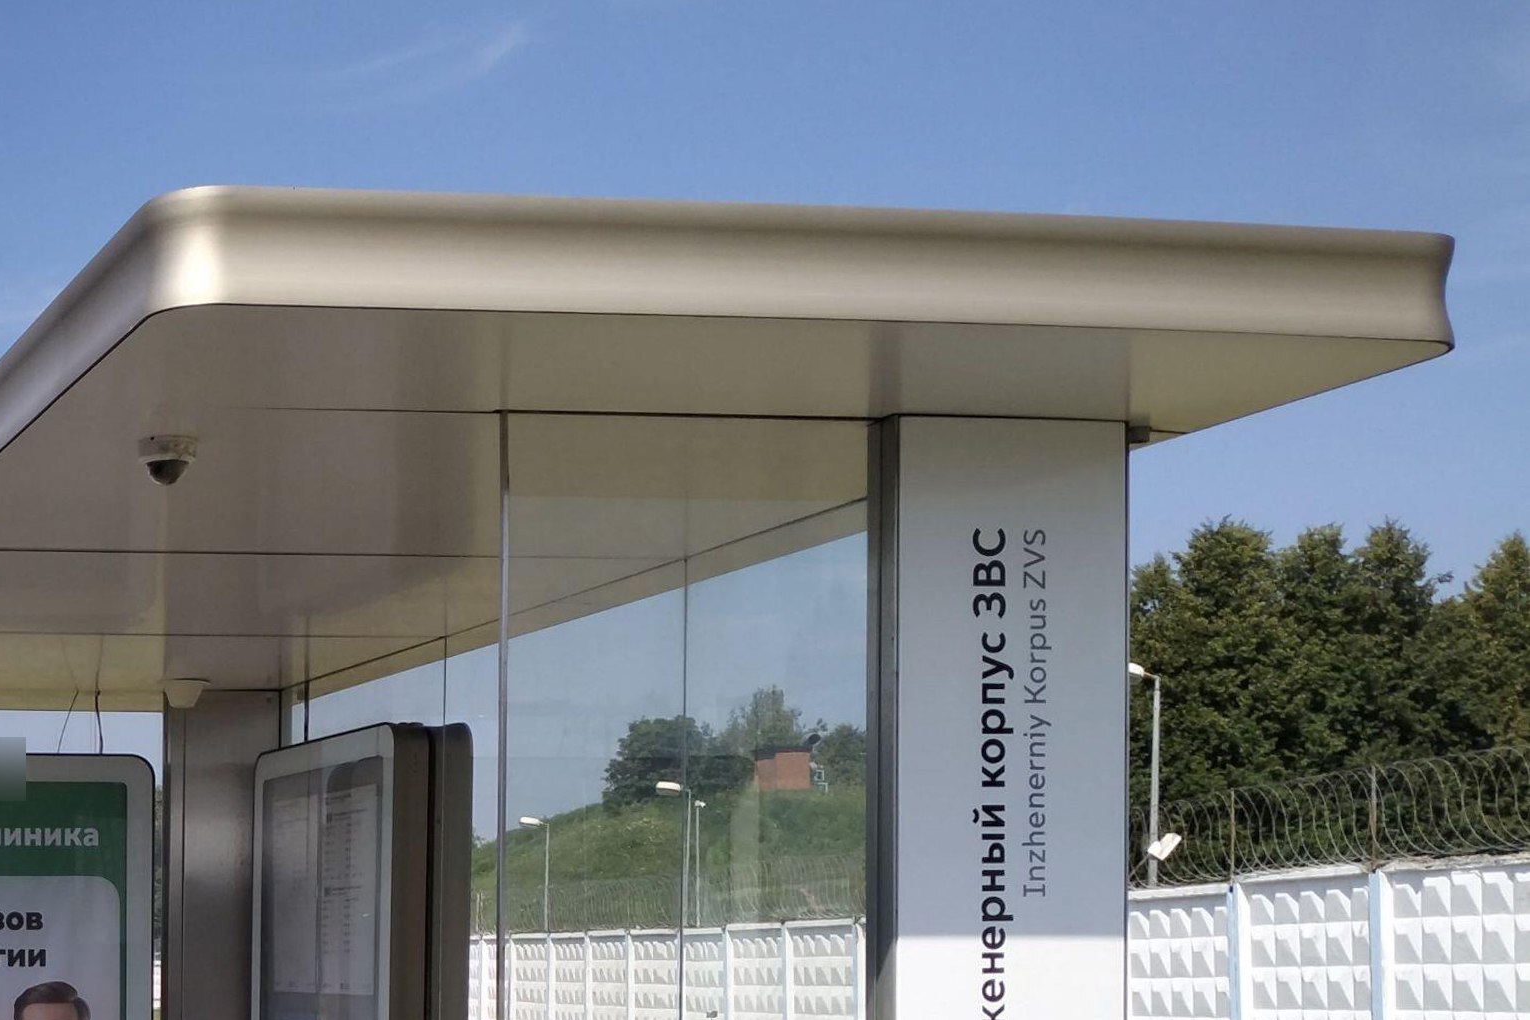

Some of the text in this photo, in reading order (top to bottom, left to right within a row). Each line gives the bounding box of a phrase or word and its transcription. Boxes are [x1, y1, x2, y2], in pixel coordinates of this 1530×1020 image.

[972, 526, 1008, 619] ЗВС
[980, 633, 1014, 789] корпус
[1023, 528, 1053, 898] Inzhenerniy Korpus ZVS
